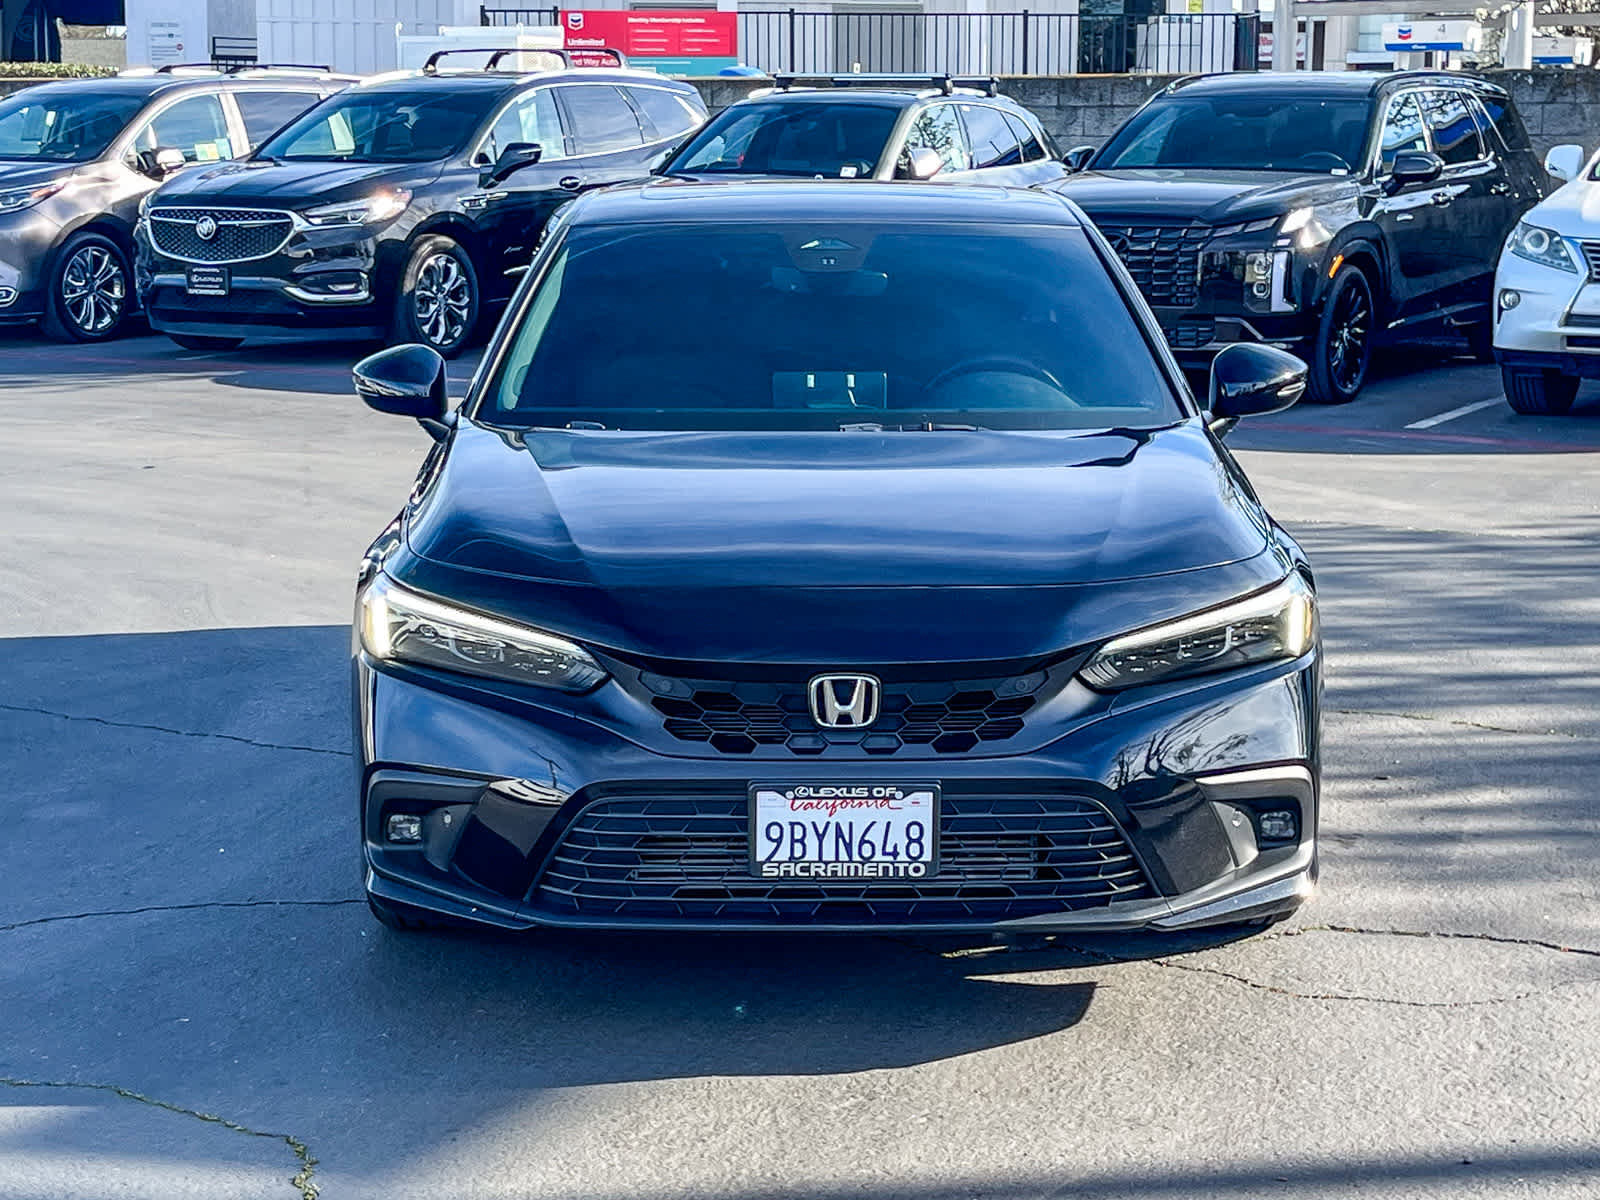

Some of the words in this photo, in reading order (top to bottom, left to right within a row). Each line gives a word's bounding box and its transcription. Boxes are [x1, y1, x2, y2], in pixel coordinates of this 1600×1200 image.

[567, 38, 605, 46] Unlimited
[811, 787, 869, 797] LEXUS
[872, 787, 897, 797] OF
[765, 821, 924, 861] 9BYN648
[762, 862, 926, 877] SACRAMENTO
